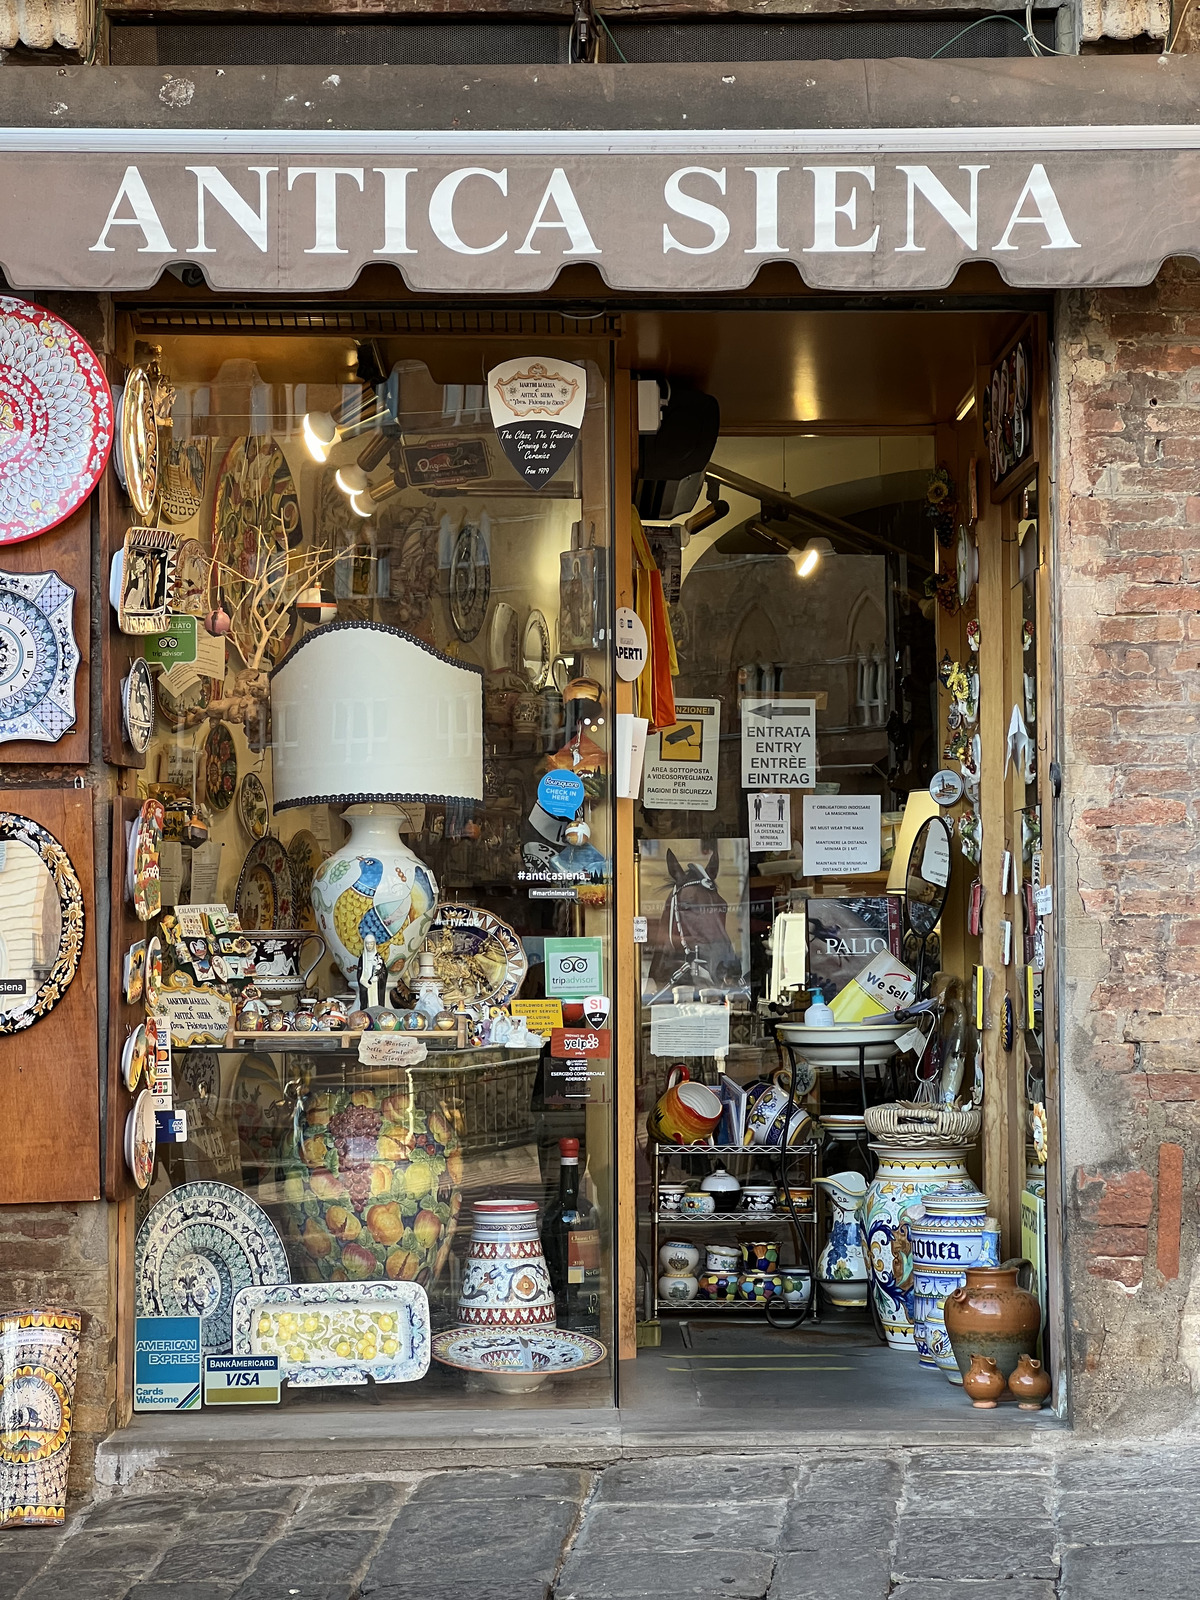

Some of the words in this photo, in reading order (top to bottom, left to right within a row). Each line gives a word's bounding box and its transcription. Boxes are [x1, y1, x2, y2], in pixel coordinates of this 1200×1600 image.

[88, 166, 603, 255] ANTICA
[662, 163, 1082, 254] SIENA
[501, 430, 512, 440] The
[514, 430, 532, 441] Class,
[535, 430, 547, 440] The
[549, 430, 574, 440] Tradition
[517, 441, 540, 452] Growing
[549, 441, 557, 449] be
[675, 706, 711, 715] NZIONE!
[747, 726, 811, 738] ENTRATA
[756, 742, 802, 753] ENTRY
[751, 755, 807, 769] ENTRÈE
[545, 777, 579, 788] foursquare
[748, 773, 810, 784] EINTRAG
[517, 870, 586, 881] #anticasiena
[825, 937, 888, 955] PALIO
[552, 976, 594, 985] tripadvisor
[867, 971, 886, 990] We
[886, 984, 909, 1001] Sell
[590, 999, 602, 1010] SI
[174, 1012, 195, 1020] ANTICA
[564, 1039, 588, 1050] yelp
[136, 1339, 197, 1352] AMERICAN
[149, 1353, 200, 1365] EXPRESS
[209, 1359, 276, 1369] BANKAMERICARD
[225, 1372, 260, 1386] VISA
[136, 1387, 164, 1396] Cards
[136, 1396, 179, 1404] Welcome
